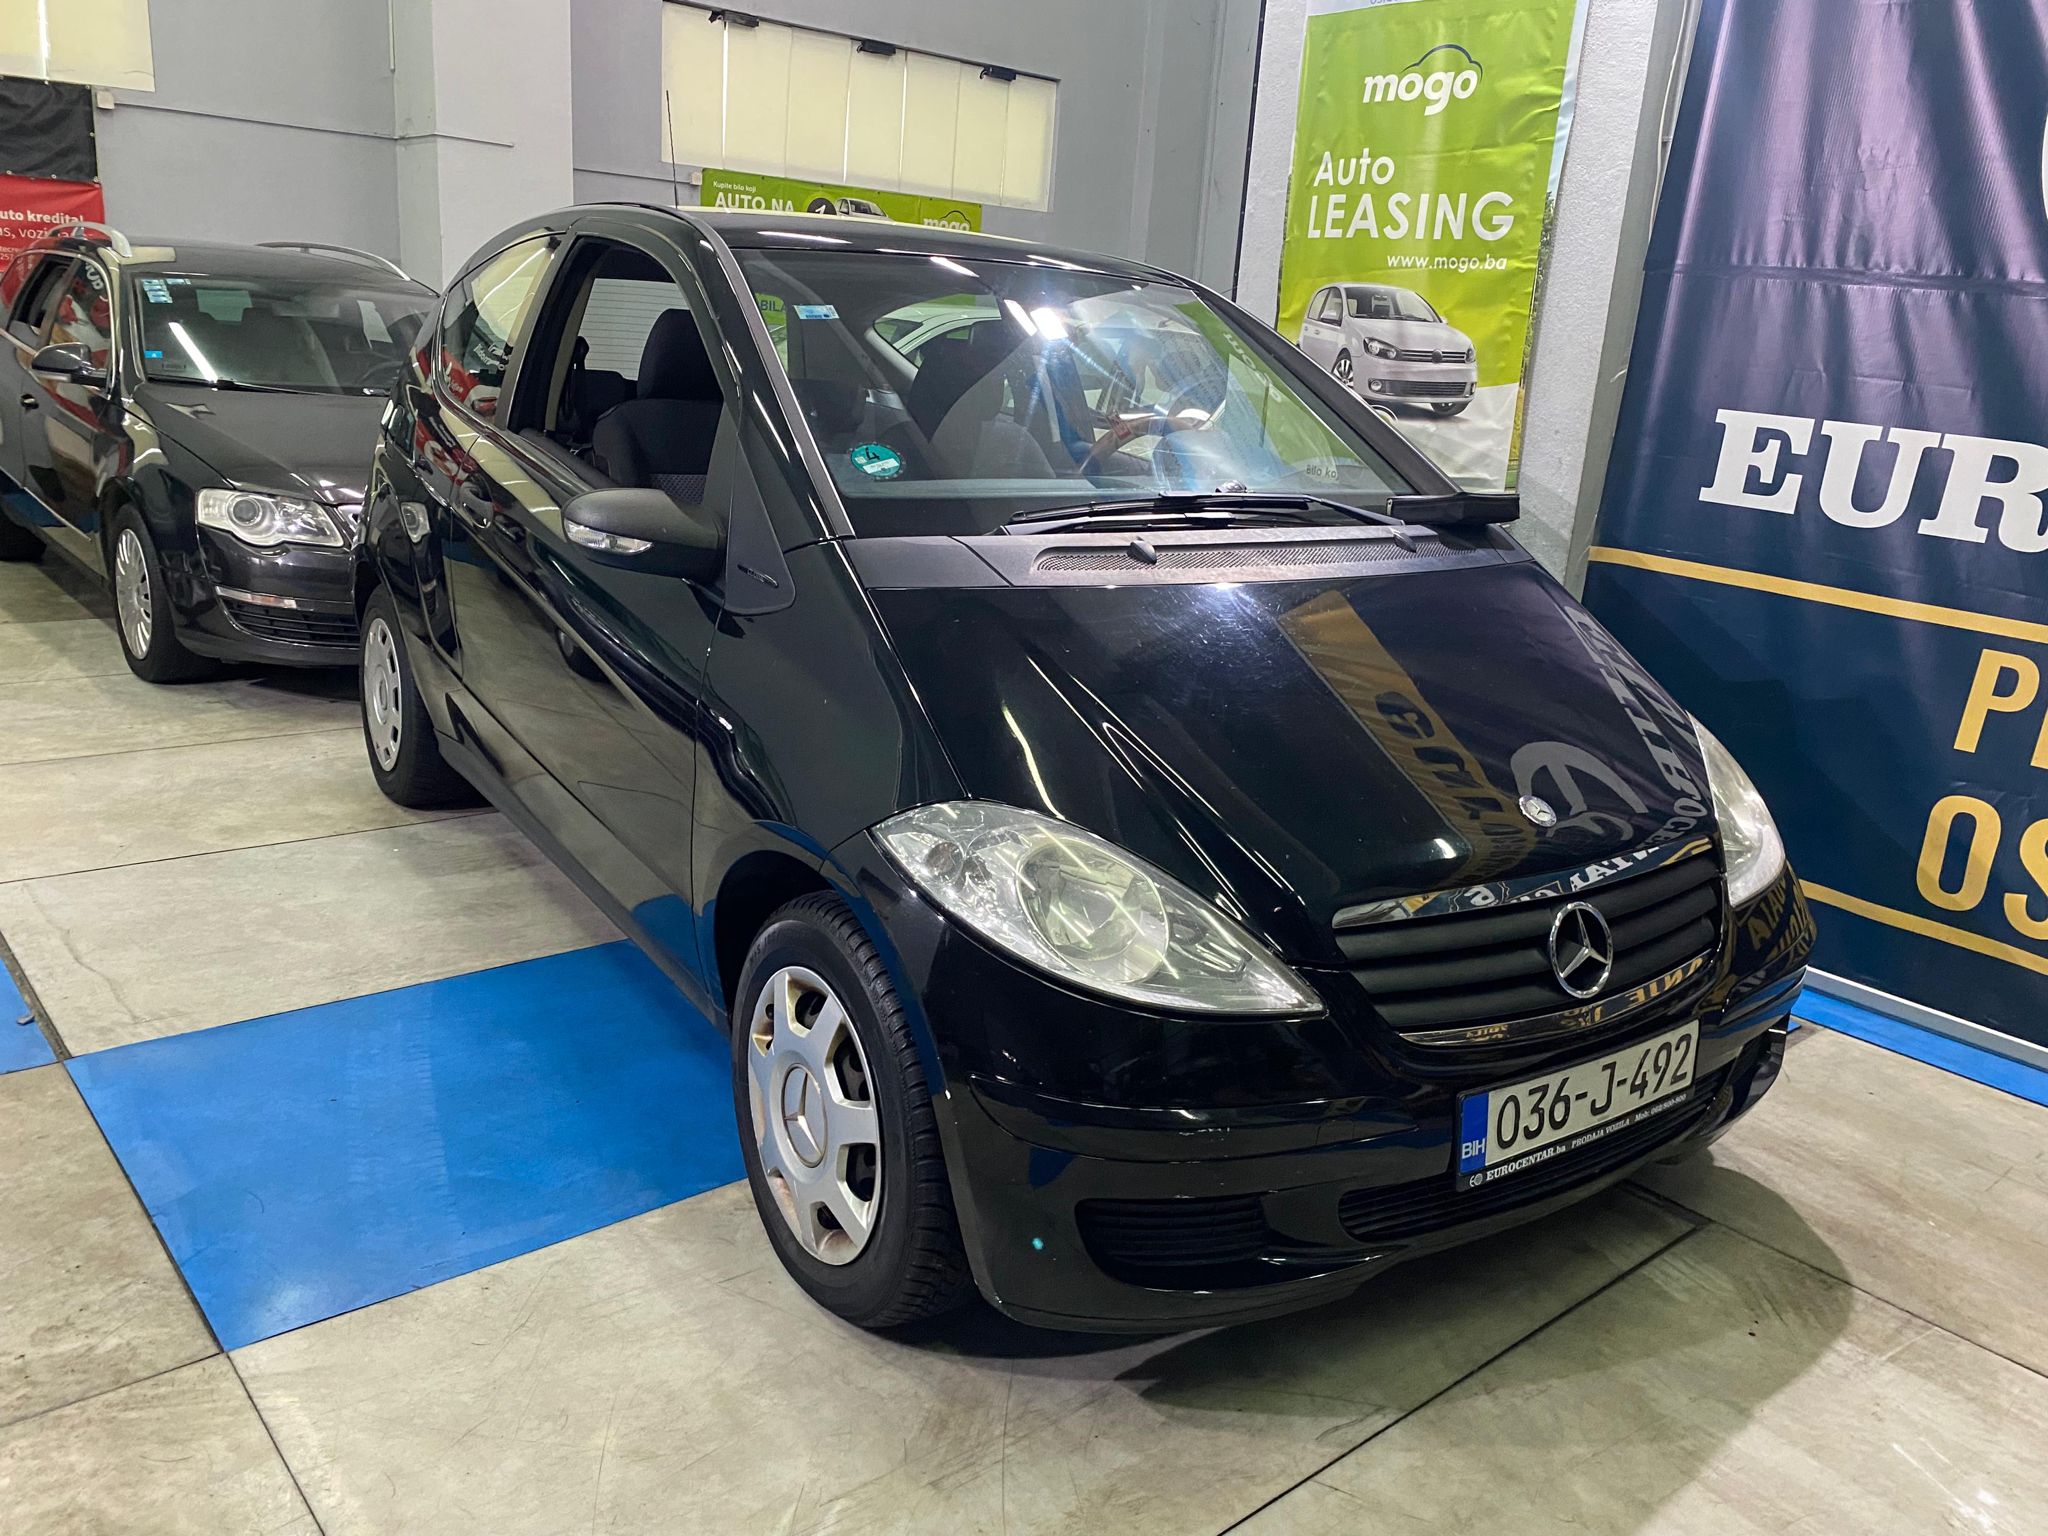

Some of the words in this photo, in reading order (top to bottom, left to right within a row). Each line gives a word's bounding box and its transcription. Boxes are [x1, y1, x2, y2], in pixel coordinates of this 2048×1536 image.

[1362, 69, 1479, 116] mogo
[713, 180, 732, 190] Kupite
[733, 182, 745, 191] bilo
[1313, 147, 1395, 187] Auto
[714, 192, 766, 210] AUTO
[771, 198, 794, 212] NA
[1307, 191, 1515, 241] LEASING
[1387, 253, 1508, 273] www.mogo.ba
[1698, 408, 2048, 553] EUR
[1496, 1033, 1692, 1150] 036-J-492
[1462, 1138, 1486, 1160] BIH
[1486, 1144, 1566, 1182] EUROCENTAR.ba
[1571, 1129, 1604, 1149] PRODAJA
